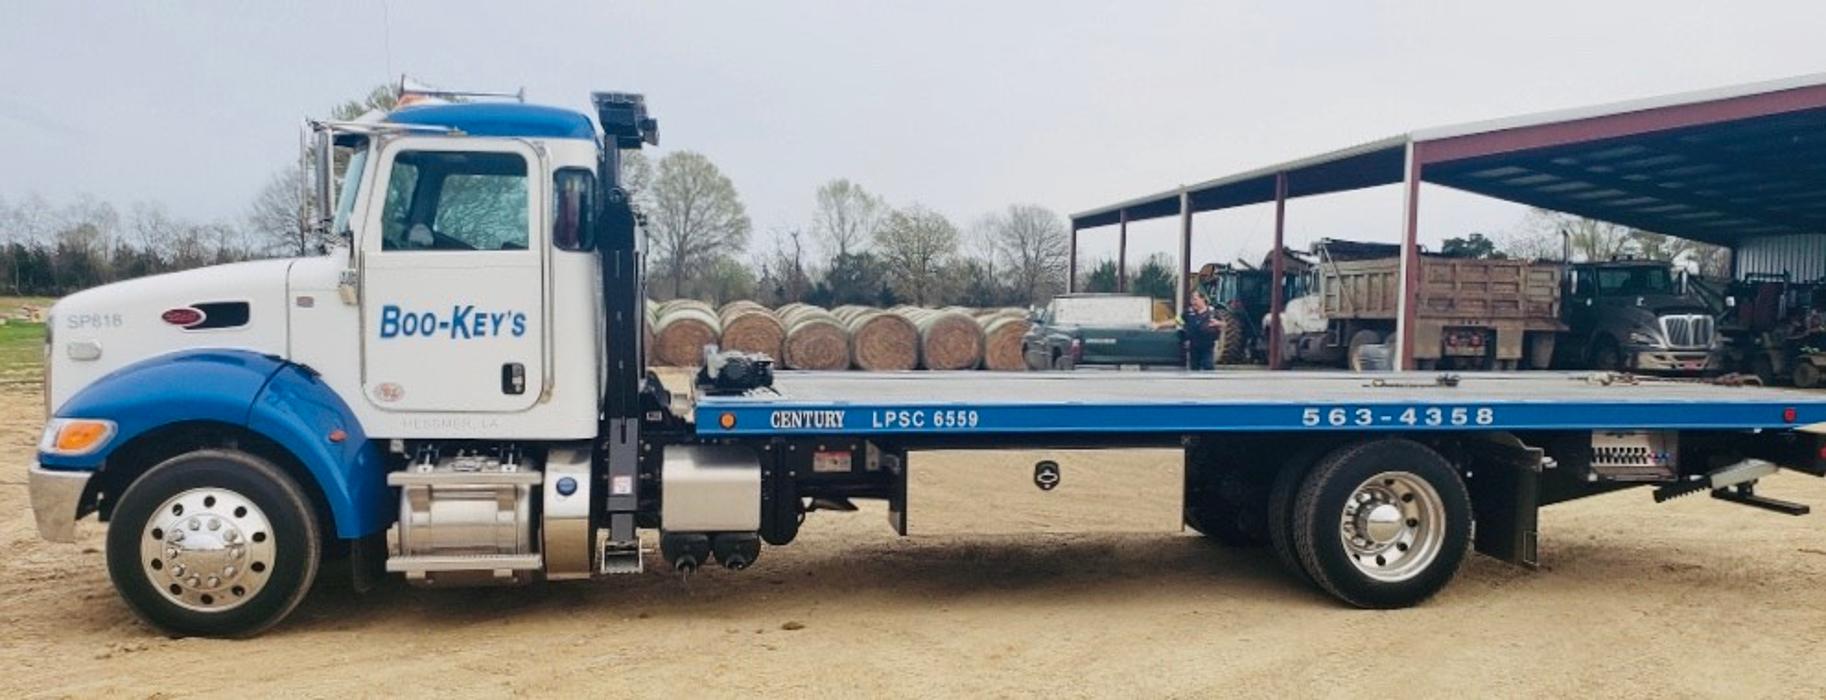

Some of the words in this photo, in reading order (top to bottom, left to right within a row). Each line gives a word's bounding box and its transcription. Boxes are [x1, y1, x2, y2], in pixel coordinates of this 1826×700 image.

[380, 304, 527, 340] BOO-KEY'S
[770, 410, 845, 429] CENTURY
[872, 411, 925, 428] LPSC
[933, 411, 979, 427] 6559
[1302, 407, 1495, 426] 563-4358
